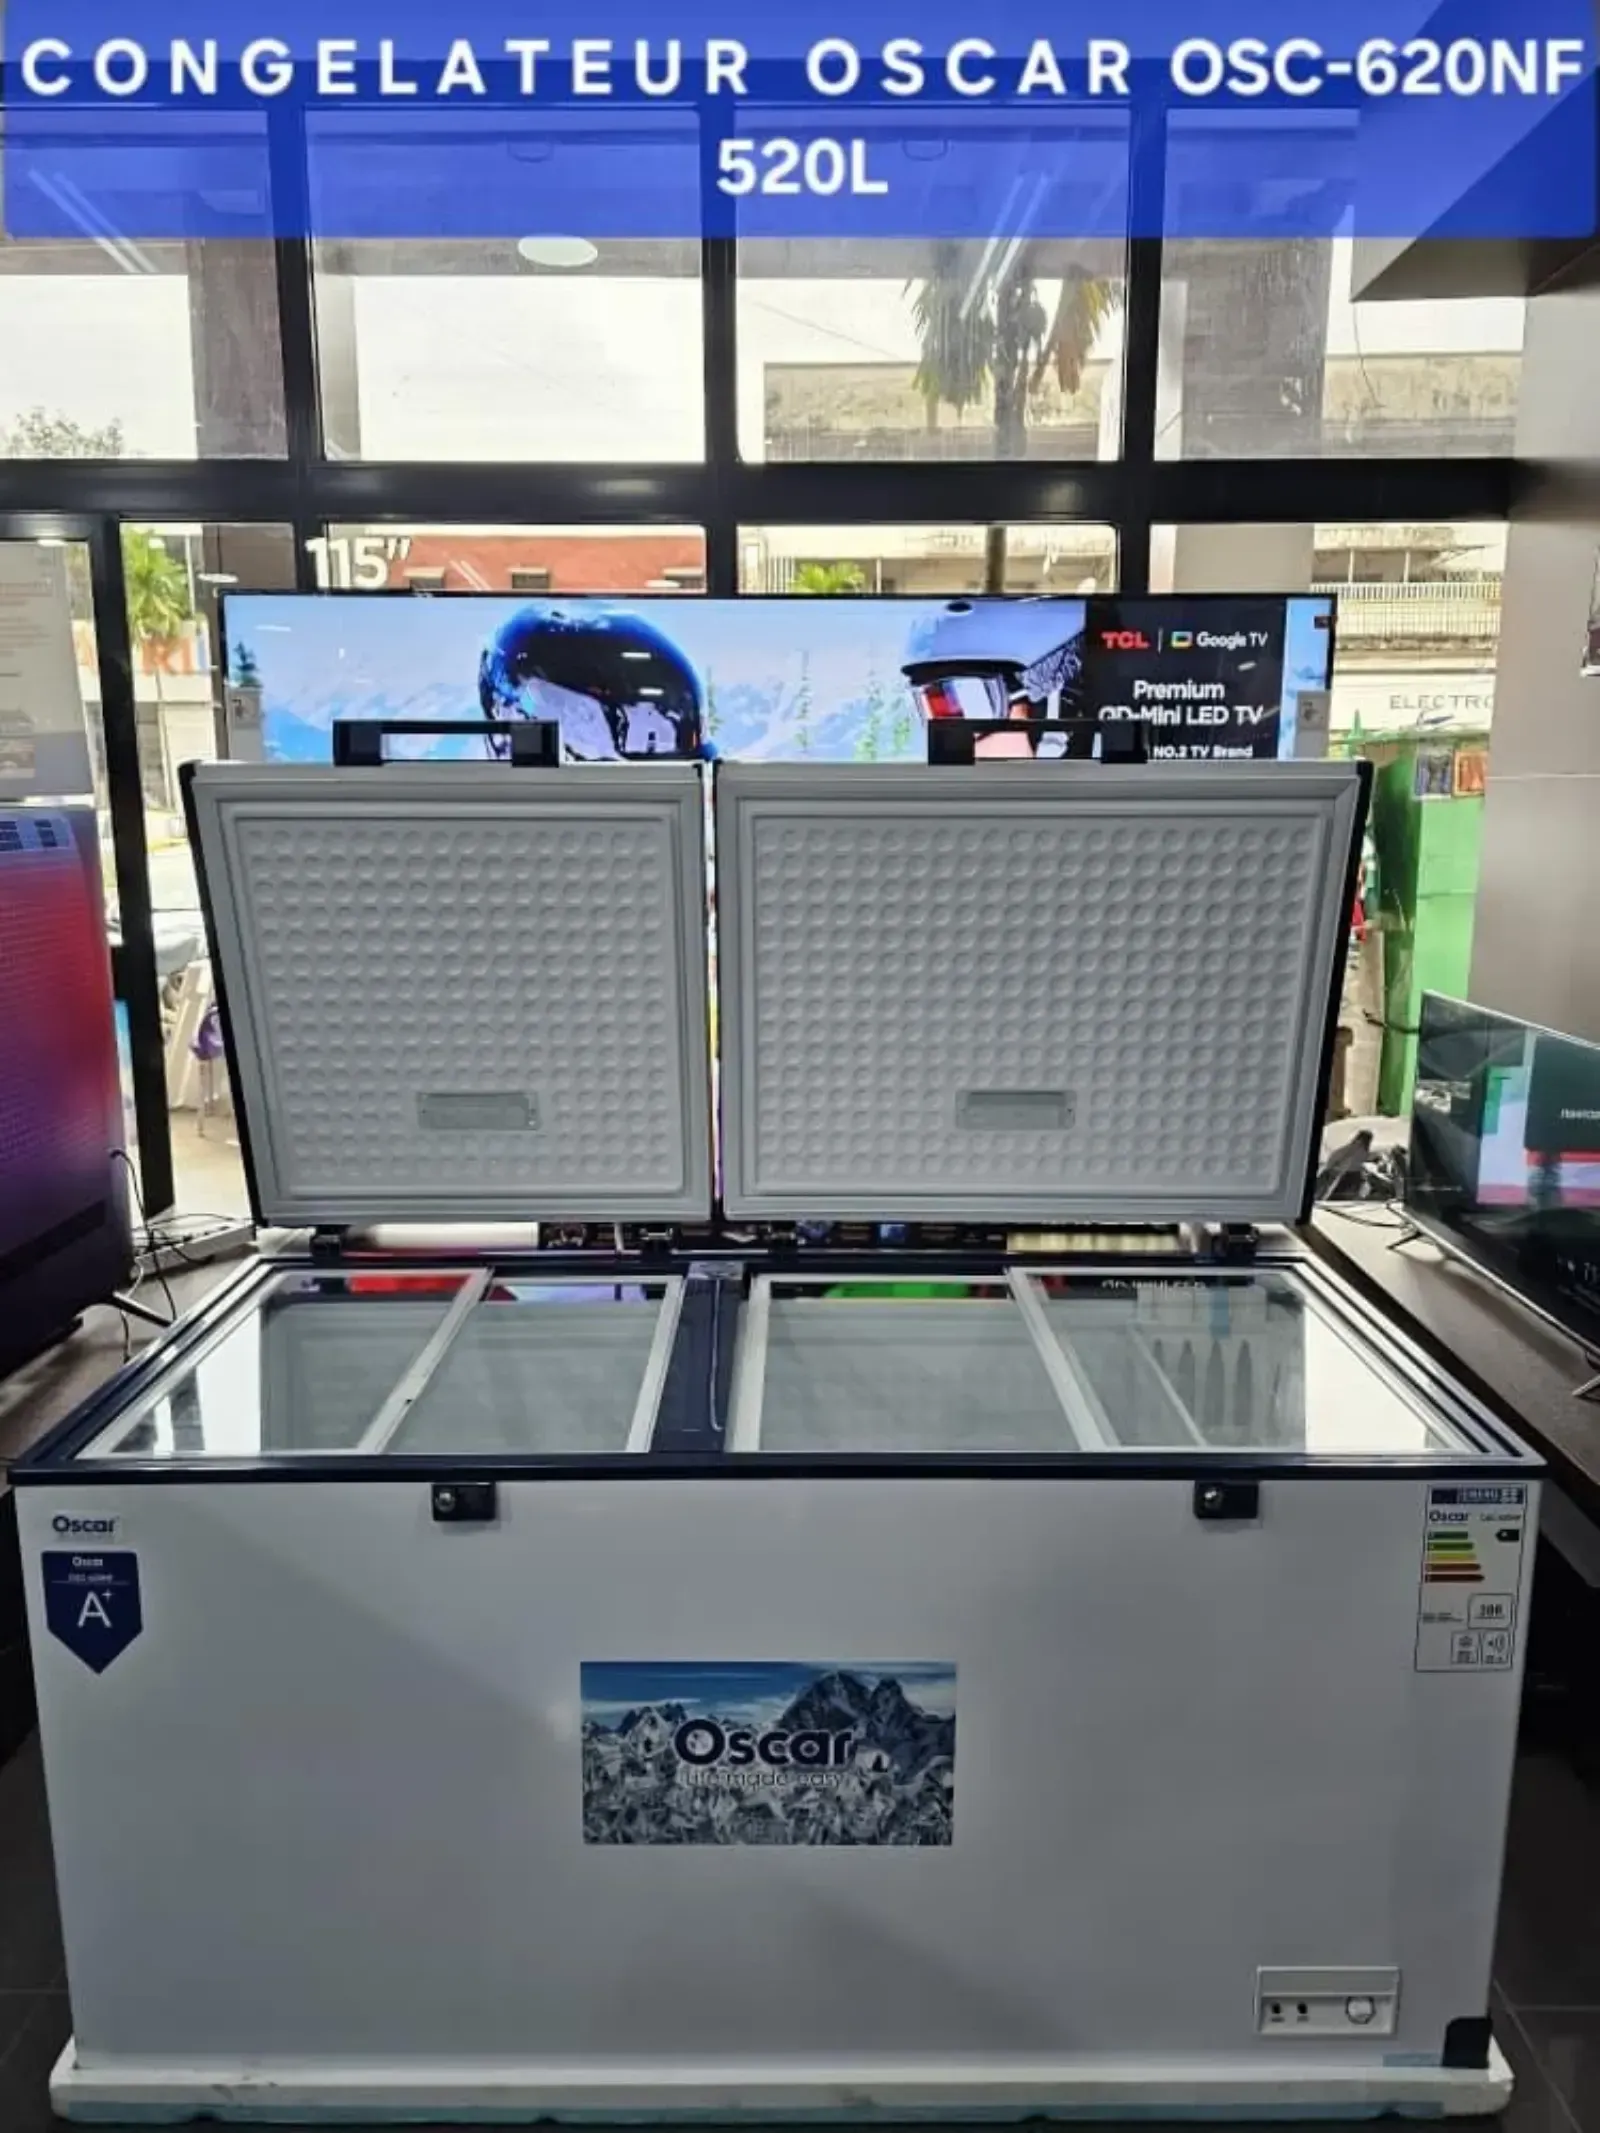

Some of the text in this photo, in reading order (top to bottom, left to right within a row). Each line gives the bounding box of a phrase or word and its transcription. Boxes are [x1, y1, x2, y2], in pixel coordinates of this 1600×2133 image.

[1102, 631, 1268, 650] TCL Google TV
[1133, 679, 1226, 699] Premium
[1186, 705, 1229, 725] LED
[1233, 705, 1264, 725] TV
[52, 1515, 115, 1532] Oscar
[673, 1718, 853, 1766] Oscar
